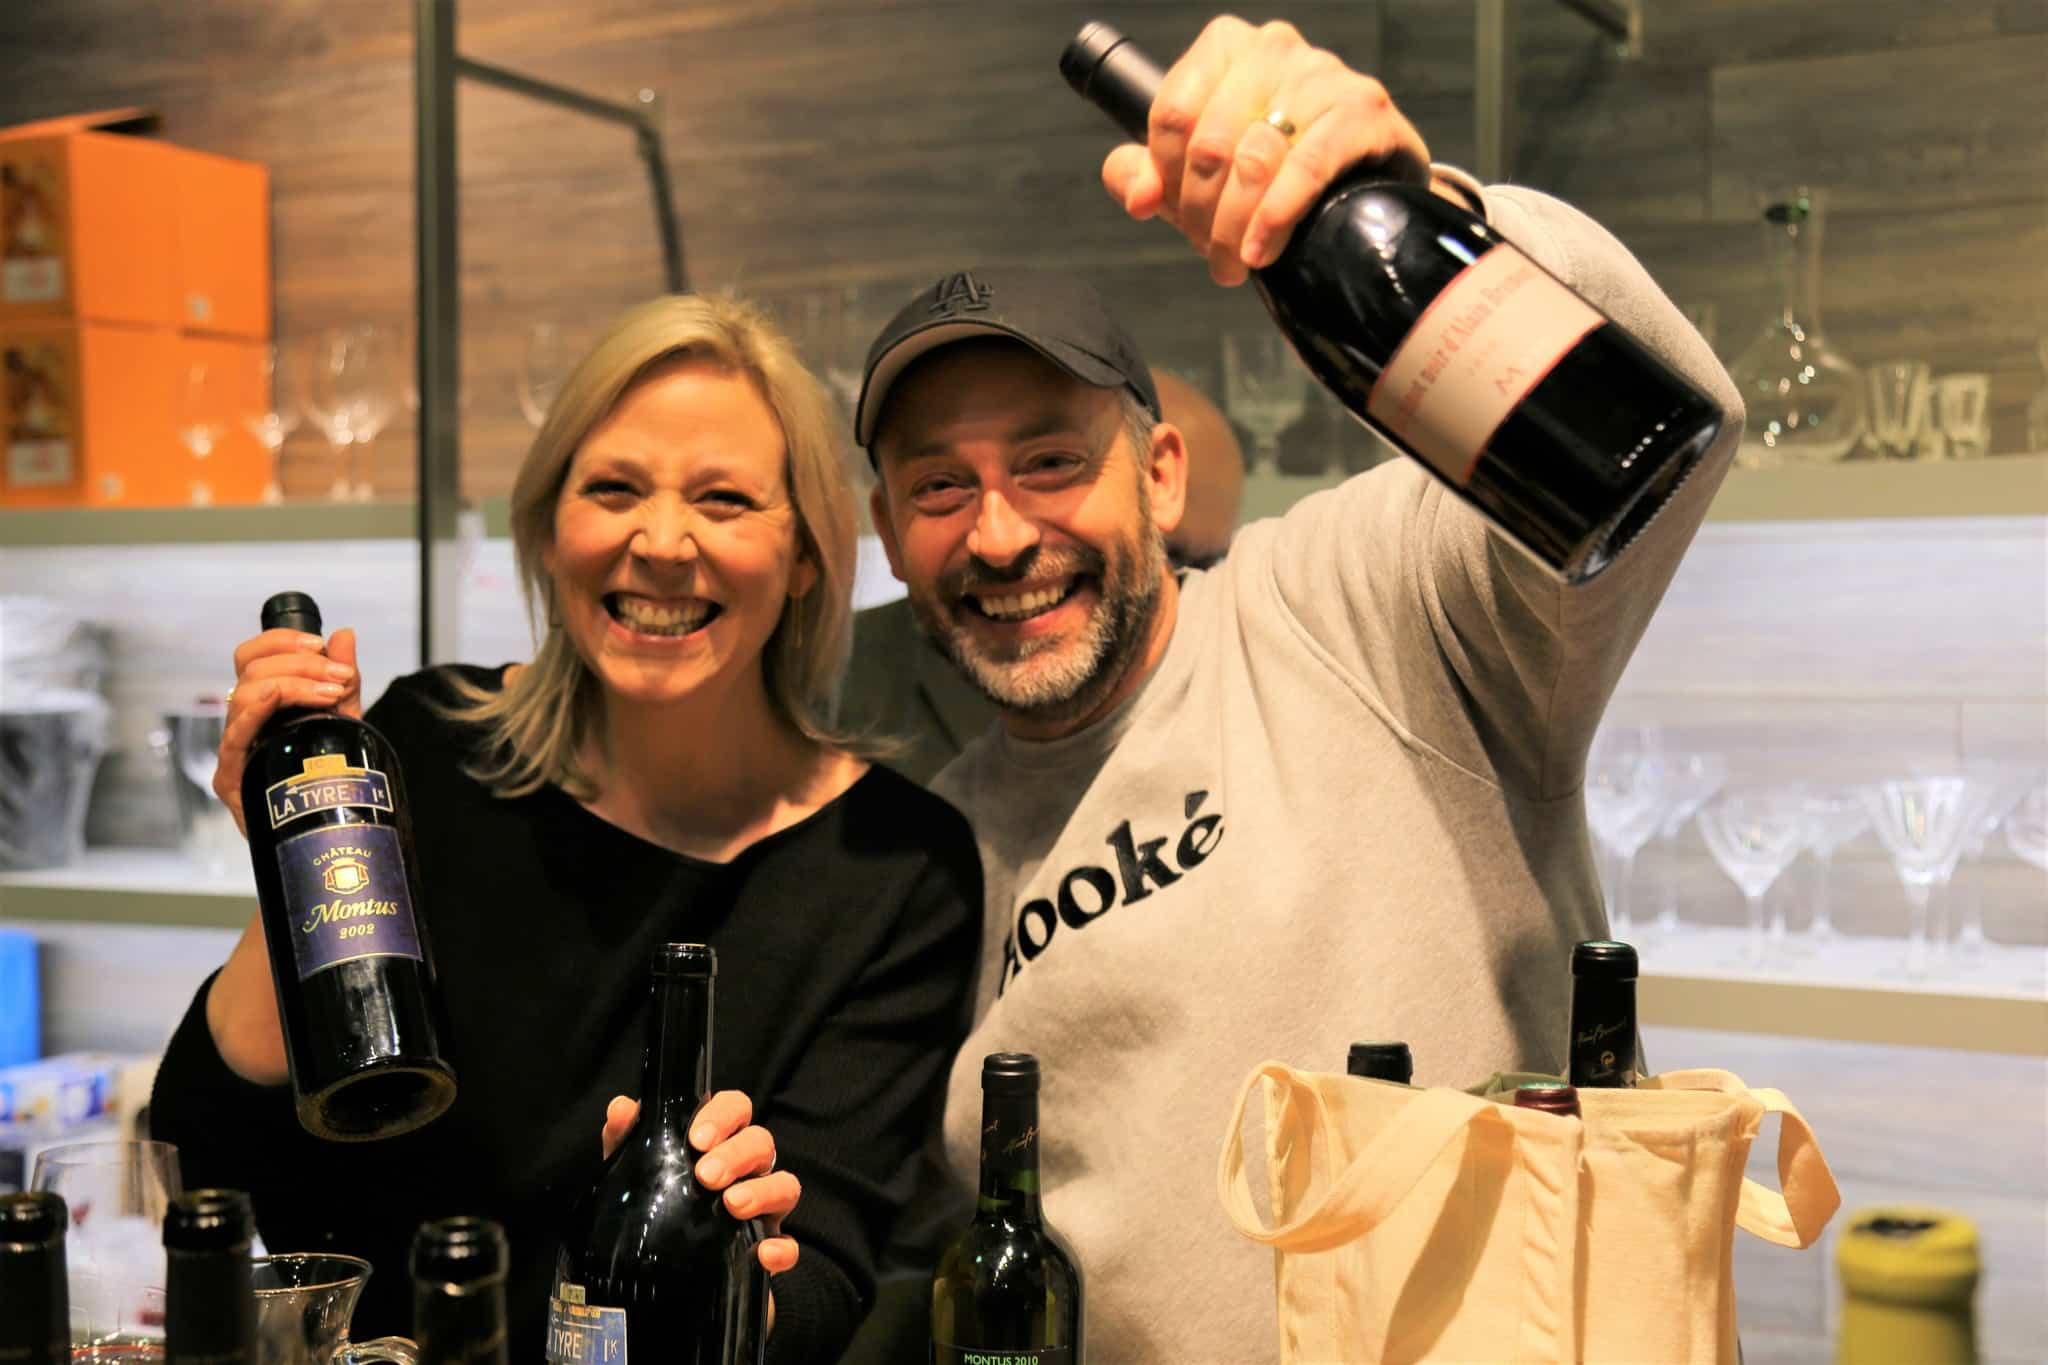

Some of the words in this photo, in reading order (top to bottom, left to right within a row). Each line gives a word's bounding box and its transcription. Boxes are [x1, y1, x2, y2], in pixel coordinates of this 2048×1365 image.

[273, 798, 297, 821] LA
[299, 783, 351, 809] TYRE
[313, 846, 373, 867] CHÂTEAU
[302, 898, 399, 933] Montus
[339, 923, 376, 940] 2002
[554, 1328, 583, 1360] TYRE
[964, 1353, 1012, 1365] MONTUS
[1014, 1355, 1039, 1365] 2010
